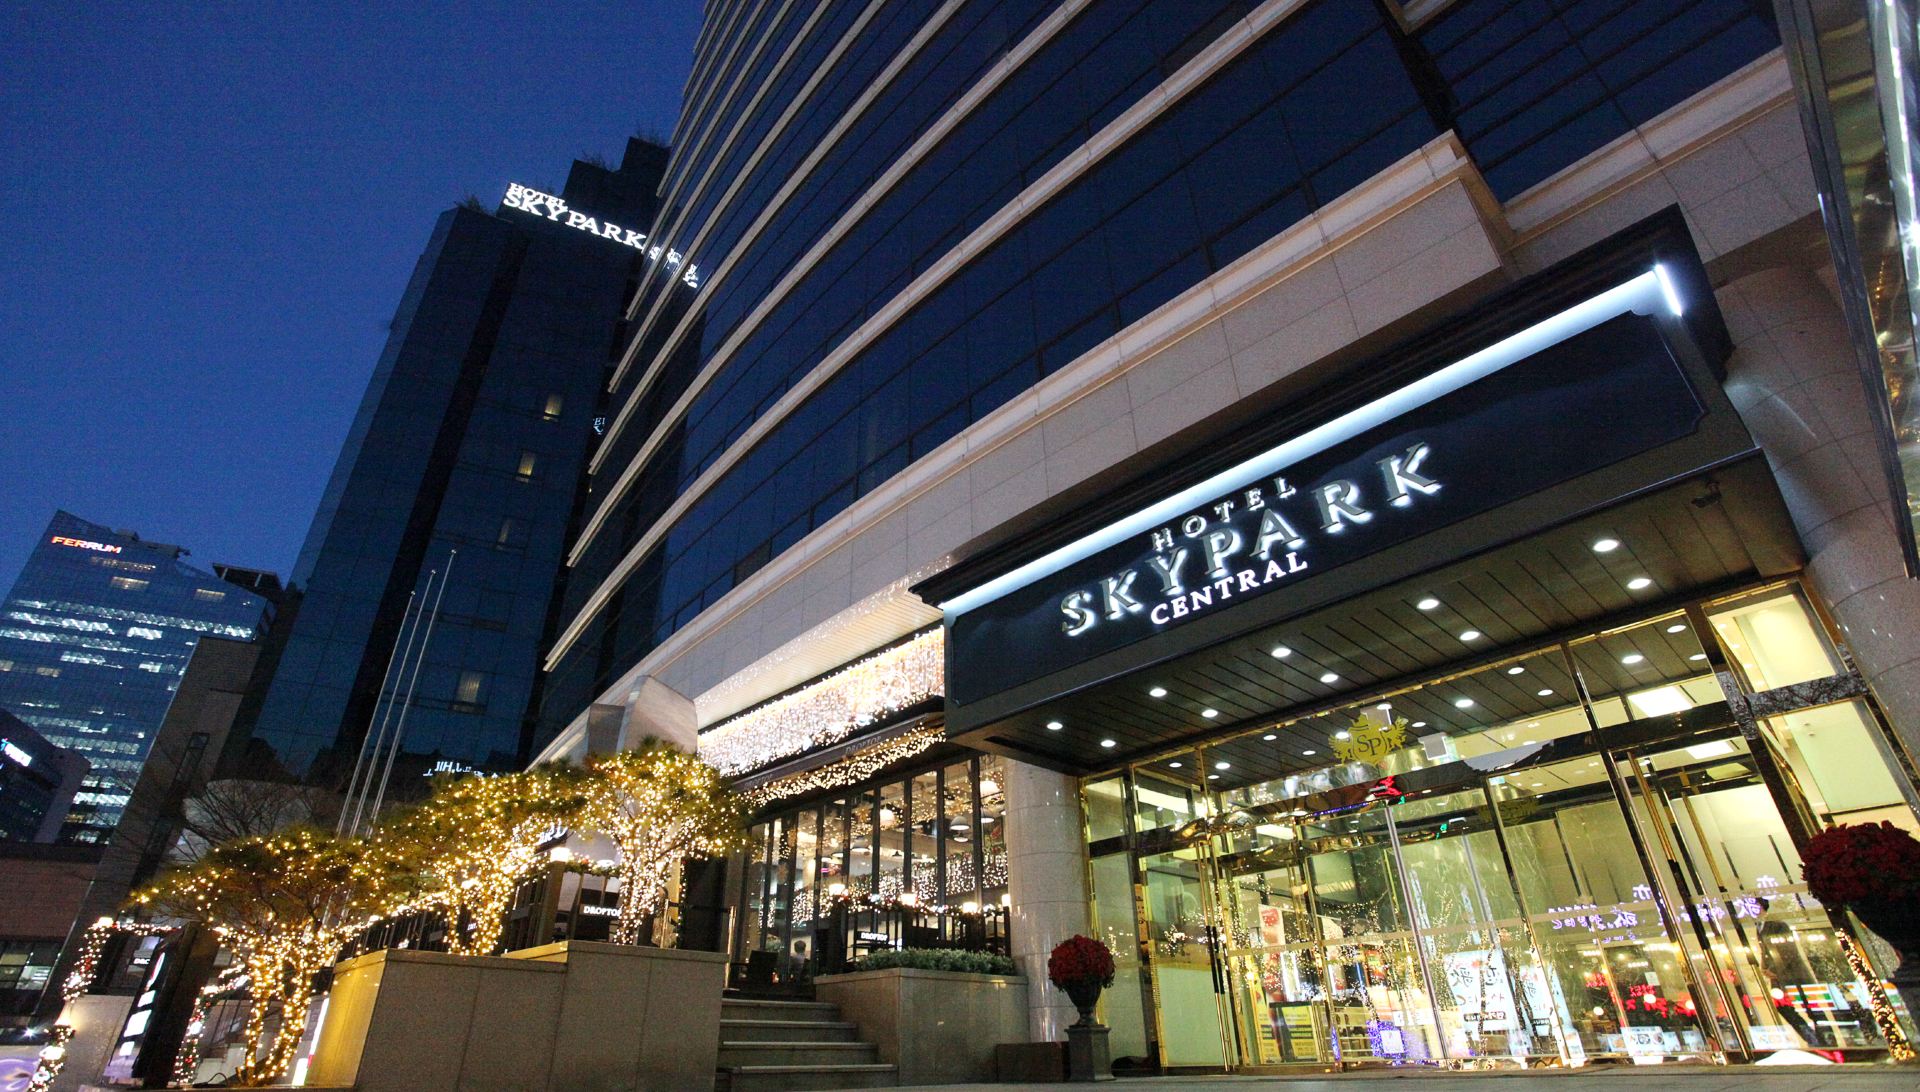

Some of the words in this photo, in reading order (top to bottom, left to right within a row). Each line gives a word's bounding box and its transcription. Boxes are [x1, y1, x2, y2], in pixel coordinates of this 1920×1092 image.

[503, 191, 648, 251] SKYPARK
[509, 182, 567, 208] HOTEL
[51, 535, 122, 554] FERRUM
[1061, 442, 1441, 636] SKYPARK
[1151, 477, 1297, 552] HOTEL
[1150, 551, 1308, 625] CENTRAL
